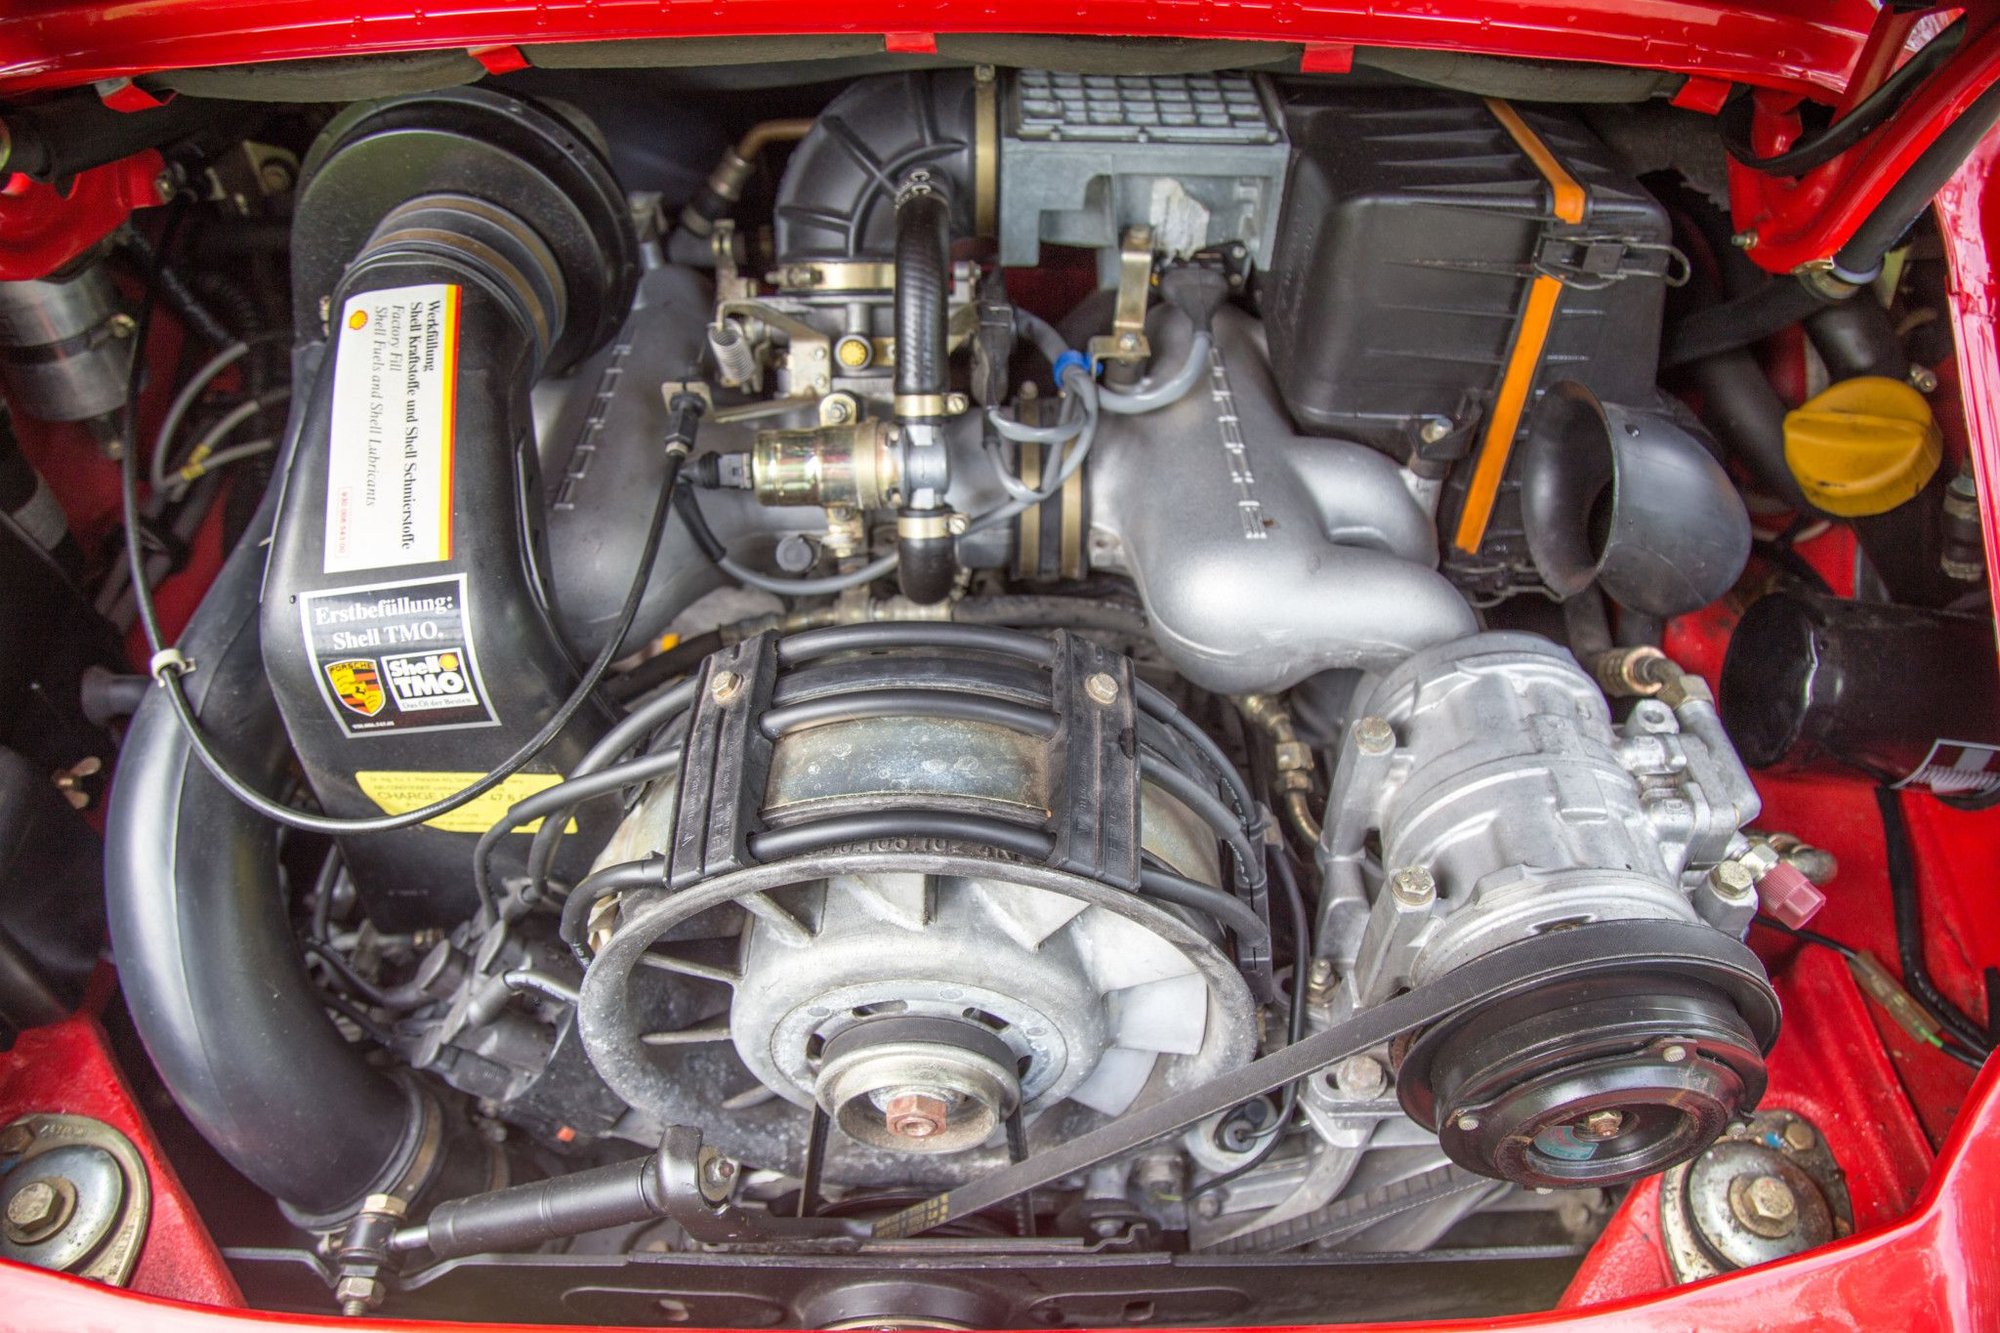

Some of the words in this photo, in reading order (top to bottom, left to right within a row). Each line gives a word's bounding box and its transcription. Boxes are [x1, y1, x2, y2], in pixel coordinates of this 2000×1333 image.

[373, 306, 388, 336] Shell
[390, 305, 405, 348] Factory
[409, 301, 424, 332] Shell
[423, 300, 441, 372] Werkfüllung
[372, 340, 386, 372] Fuels
[390, 352, 403, 372] Fill
[407, 336, 422, 396] Kraftstoffe
[370, 374, 384, 400] and
[369, 402, 383, 435] Shell
[406, 399, 418, 423] und
[405, 426, 419, 459] Shell
[366, 438, 382, 507] Lubricants
[401, 462, 417, 550] Schmierstoffe
[315, 595, 453, 626] Erstbefüllung:
[332, 627, 380, 650] Shell
[383, 621, 444, 644] TMO.
[328, 661, 374, 673] PORSCHE
[389, 656, 441, 677] Shell
[394, 671, 464, 698] TMO
